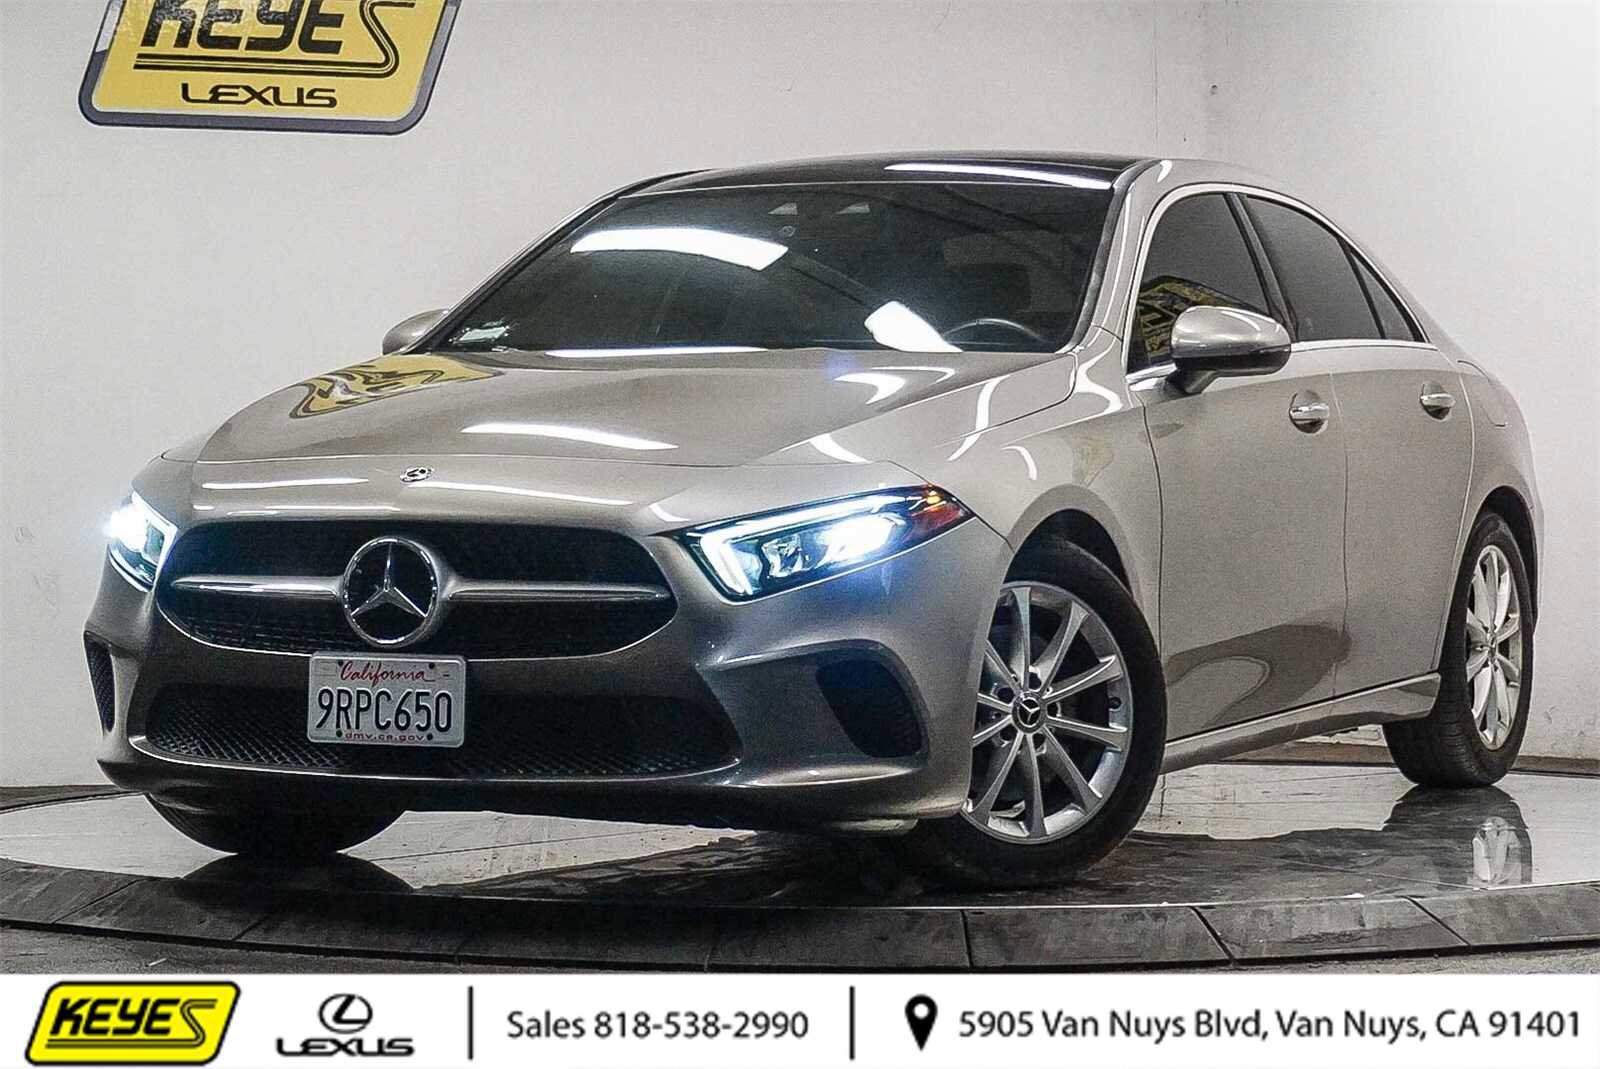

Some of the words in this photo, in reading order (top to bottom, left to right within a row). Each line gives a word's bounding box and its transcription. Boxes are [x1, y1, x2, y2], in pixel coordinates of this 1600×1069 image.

[134, 0, 415, 78] KEYES
[181, 82, 337, 108] LEXUS
[340, 660, 435, 687] California
[316, 688, 452, 732] 9RPC650
[345, 731, 425, 742] dmv.ca.gov
